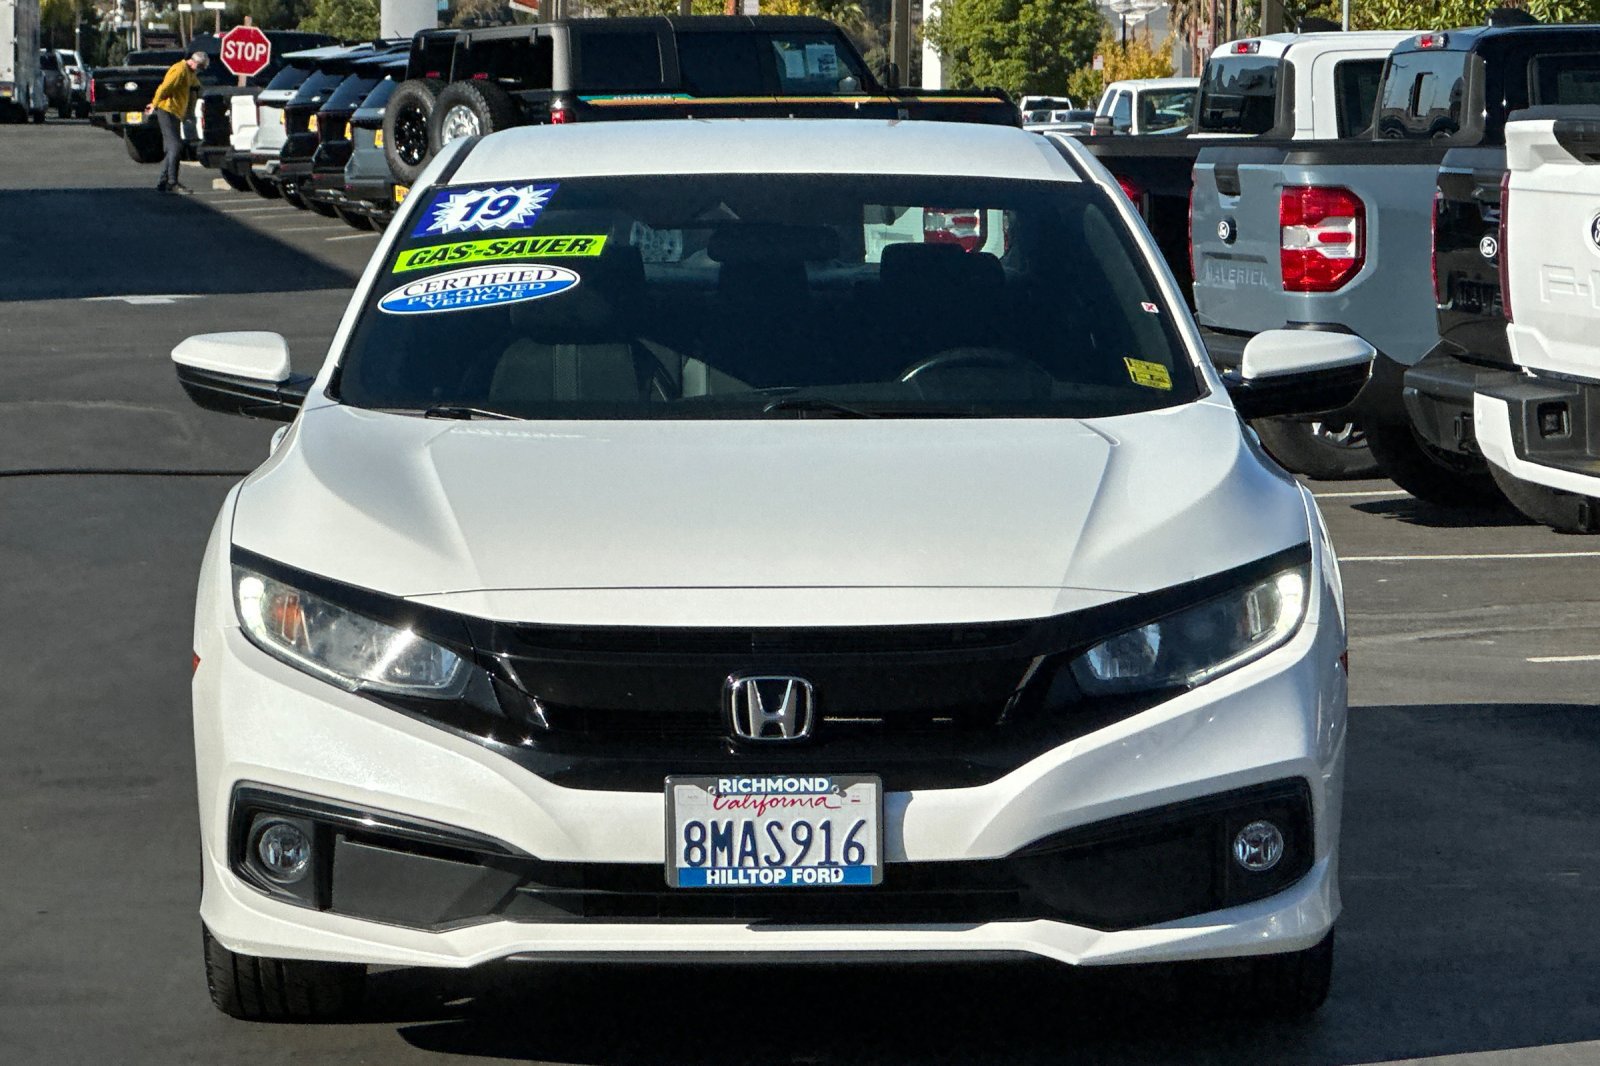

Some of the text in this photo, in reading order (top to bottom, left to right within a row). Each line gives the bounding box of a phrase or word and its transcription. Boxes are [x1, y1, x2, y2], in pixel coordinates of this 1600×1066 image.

[225, 40, 266, 61] STOP
[460, 194, 520, 222] 19
[405, 237, 597, 267] GAS-SAVER
[403, 269, 557, 297] CERTIFIED
[407, 282, 547, 306] PRE-OWNED
[427, 290, 524, 309] VEHICLE
[718, 777, 829, 793] RICHMOND
[713, 794, 842, 817] California
[684, 820, 866, 867] 8MAS916
[706, 868, 844, 884] HILLTOP FORD
